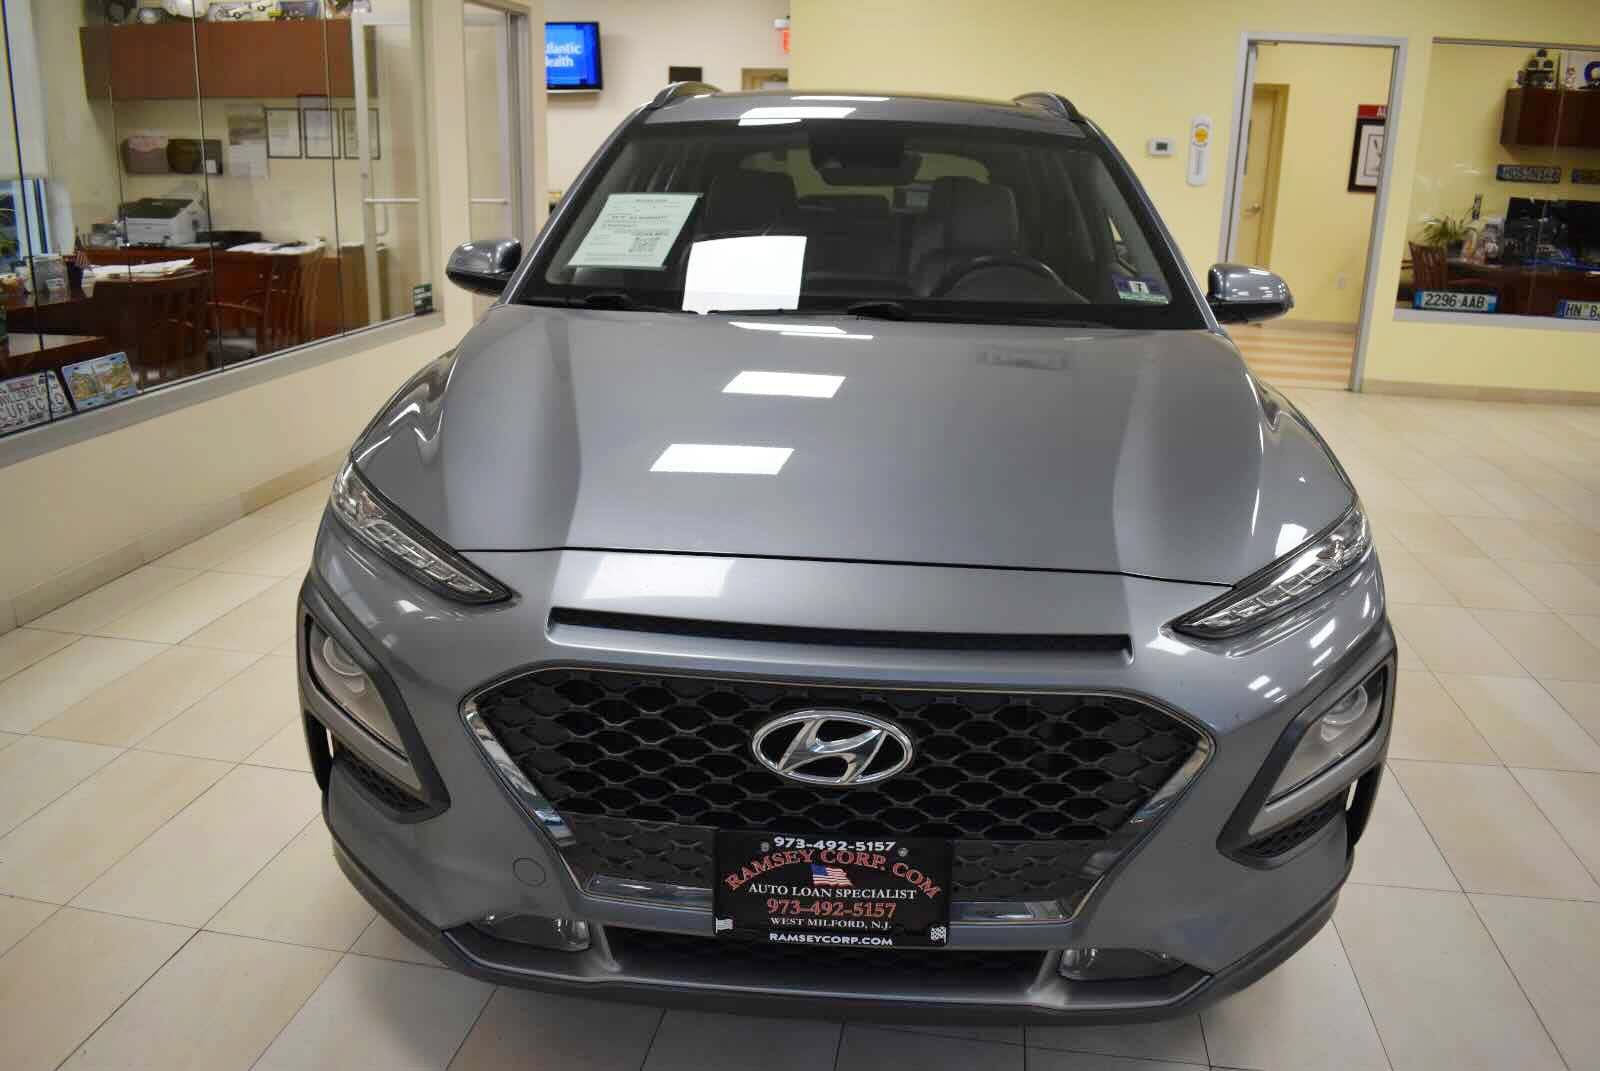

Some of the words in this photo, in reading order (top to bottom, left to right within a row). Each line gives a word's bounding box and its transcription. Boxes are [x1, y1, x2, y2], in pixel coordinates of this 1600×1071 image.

[1425, 293, 1456, 307] 2296
[1462, 295, 1486, 309] AAB
[1566, 303, 1582, 317] HN
[774, 836, 896, 851] 973-492-5157
[724, 850, 814, 891] RAMSEY
[892, 862, 941, 898] COM
[749, 883, 788, 895] AUTO
[792, 886, 832, 897] LOAN
[835, 888, 917, 900] SPECIALIST
[767, 899, 896, 917] 973-492-5157
[770, 917, 804, 926] WEST
[807, 918, 867, 929] MILFORD,
[871, 920, 892, 930] N.J.
[769, 933, 893, 946] RAMSEYCORP.COM
